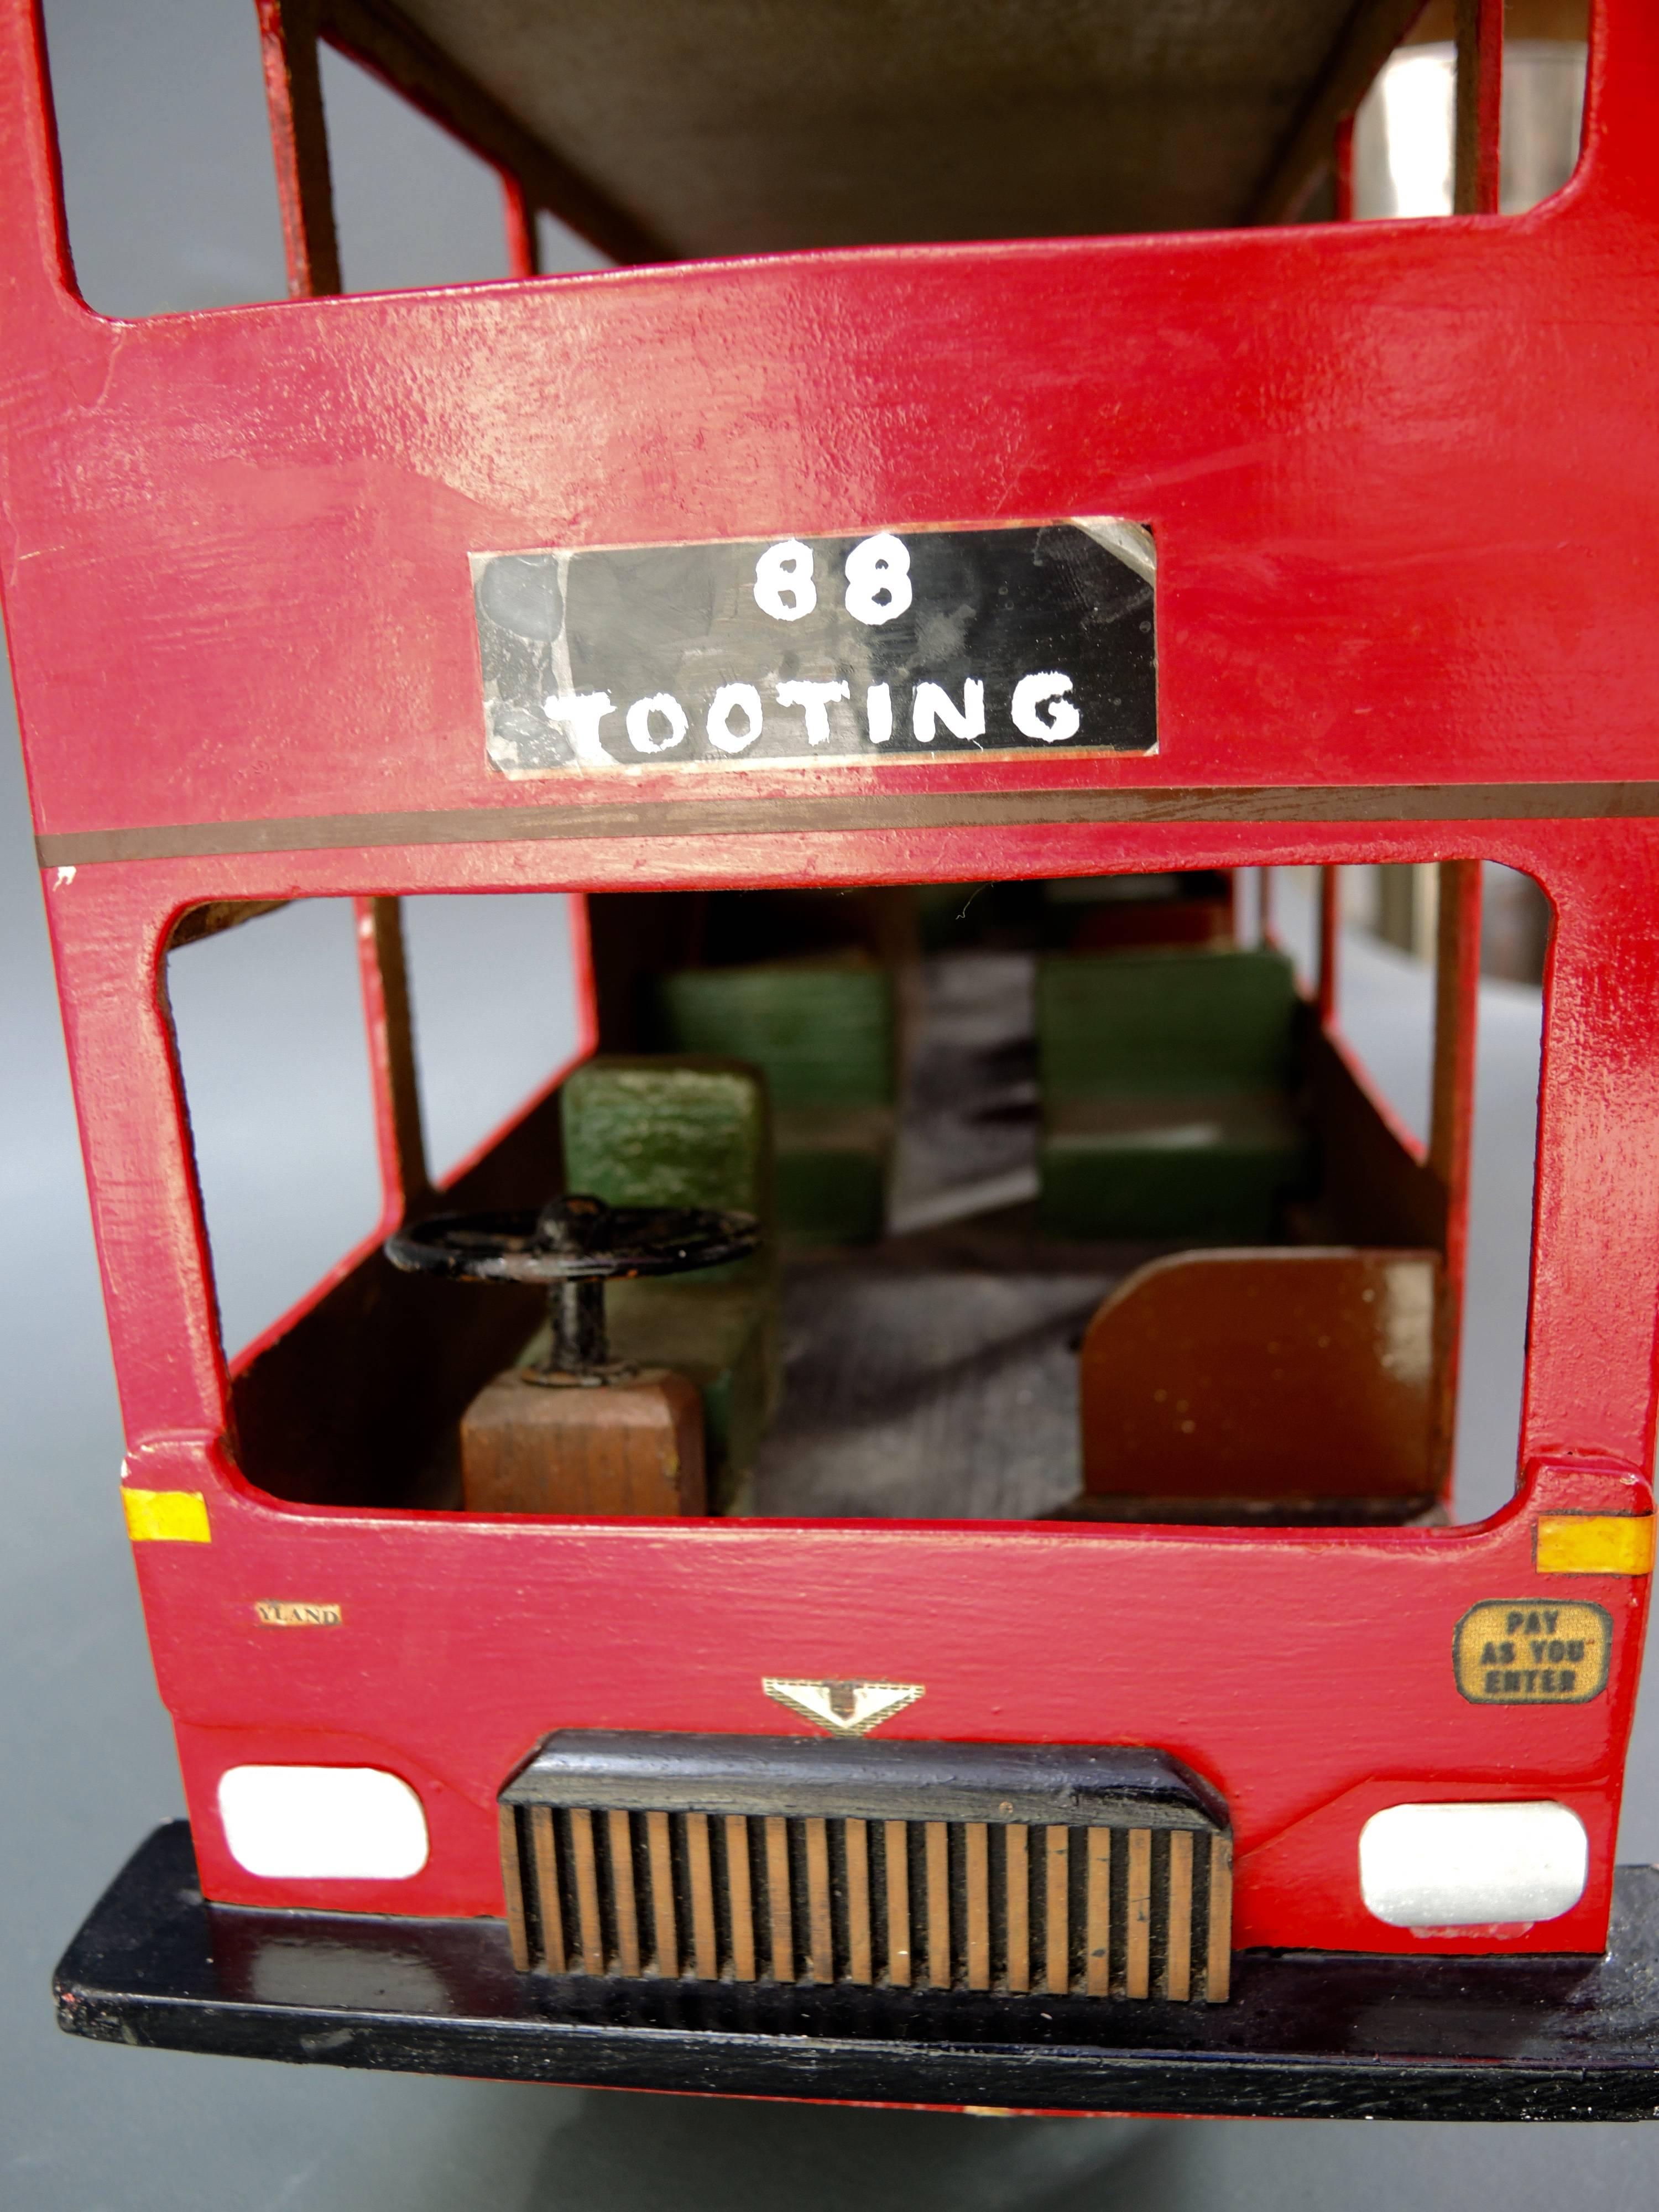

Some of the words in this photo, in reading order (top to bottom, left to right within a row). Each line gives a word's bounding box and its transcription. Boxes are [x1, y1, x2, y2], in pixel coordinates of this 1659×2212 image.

[754, 533, 912, 625] 88
[546, 670, 1080, 758] TOOTING
[1507, 1610, 1558, 1634] PAY
[1481, 1641, 1516, 1665] AS
[1530, 1638, 1585, 1663] YOU
[1484, 1669, 1575, 1693] ENTER
